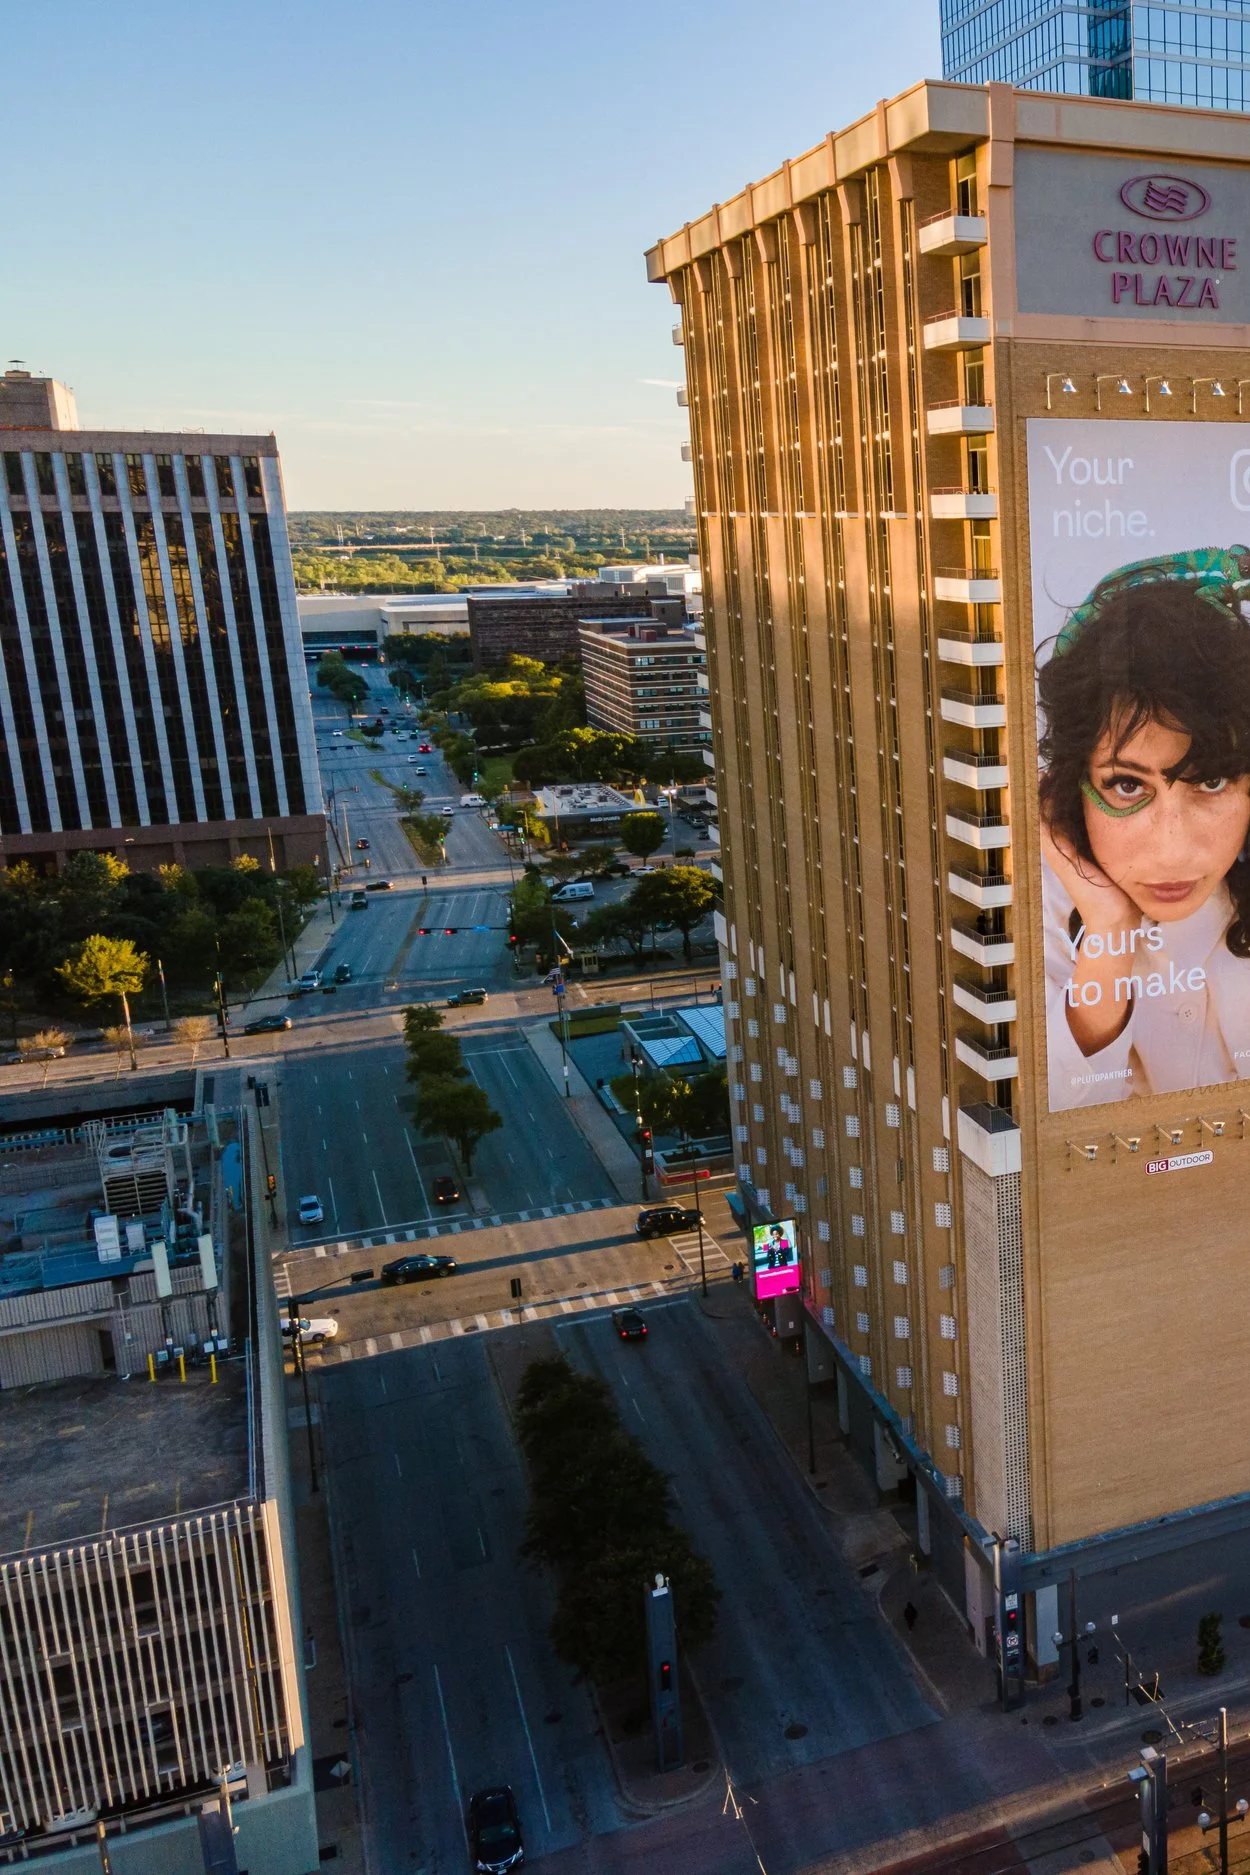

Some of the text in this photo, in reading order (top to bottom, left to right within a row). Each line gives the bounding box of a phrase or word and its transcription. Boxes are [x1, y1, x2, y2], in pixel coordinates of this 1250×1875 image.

[1092, 229, 1237, 270] CROWNE
[1112, 271, 1220, 309] PLAZA
[1043, 445, 1135, 486] Your
[1053, 499, 1156, 537] niche.
[1058, 925, 1165, 961] Yours
[1066, 961, 1206, 1008] to make
[1070, 1068, 1133, 1085] @PLUTOPANTHER
[1148, 1153, 1211, 1173] BIG OUTDOOR
